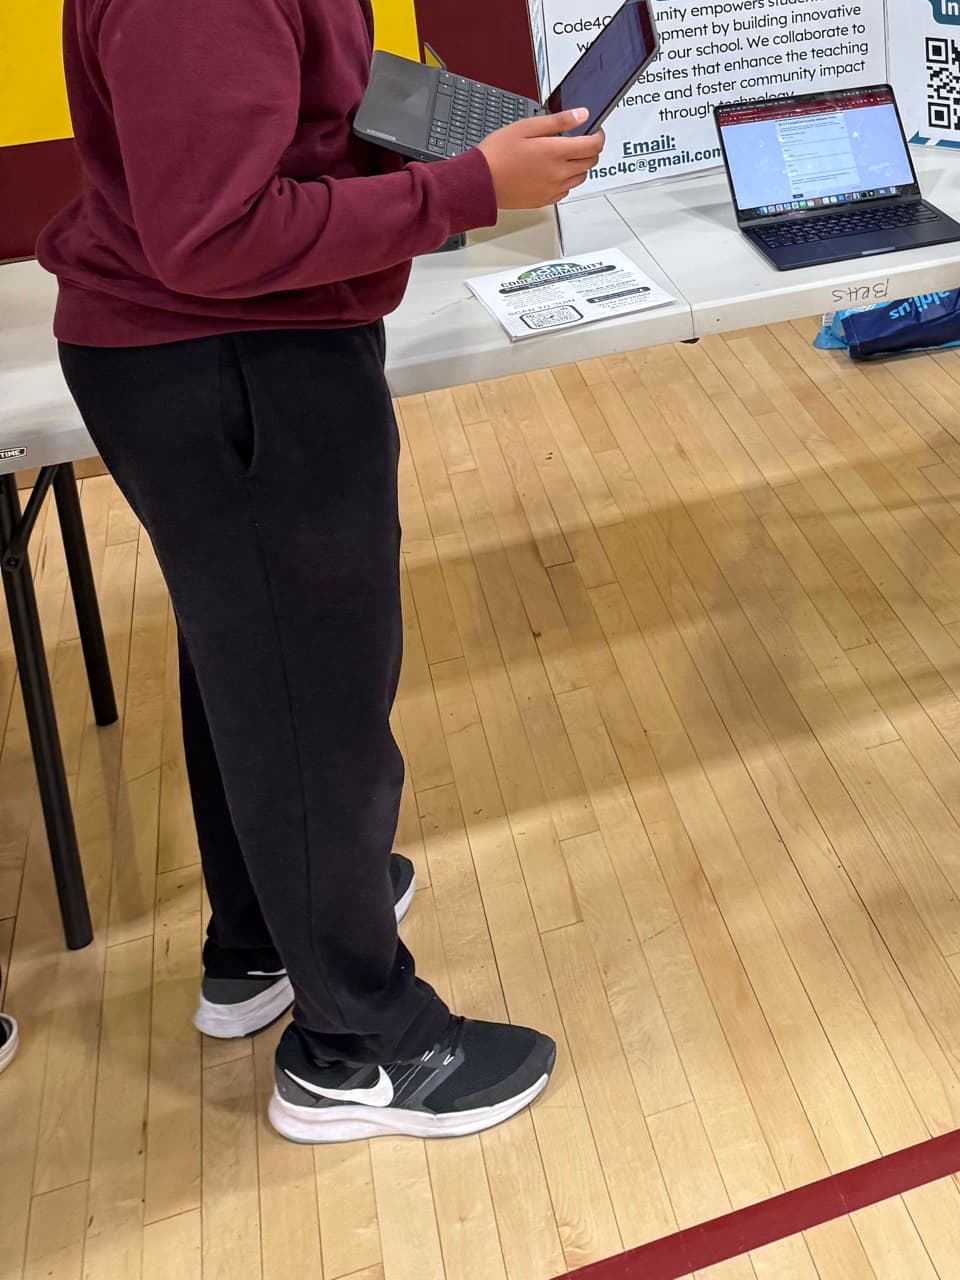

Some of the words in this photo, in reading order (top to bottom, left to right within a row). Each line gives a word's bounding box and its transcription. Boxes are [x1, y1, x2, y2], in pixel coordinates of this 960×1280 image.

[712, 21, 729, 37] by
[733, 14, 788, 31] building
[791, 4, 861, 24] innovative
[667, 47, 692, 60] our
[696, 38, 743, 57] school.
[746, 36, 770, 50] We
[772, 25, 849, 45] collaborate
[851, 23, 866, 35] to
[637, 67, 689, 84] ebsites
[691, 62, 720, 77] that
[724, 53, 783, 72] enhance
[785, 49, 808, 63] the
[810, 41, 869, 60] teaching
[664, 84, 693, 100] and
[696, 79, 737, 96] foster
[740, 67, 816, 90] community
[819, 60, 866, 78] impact
[658, 95, 715, 122] through
[622, 134, 676, 156] Email:
